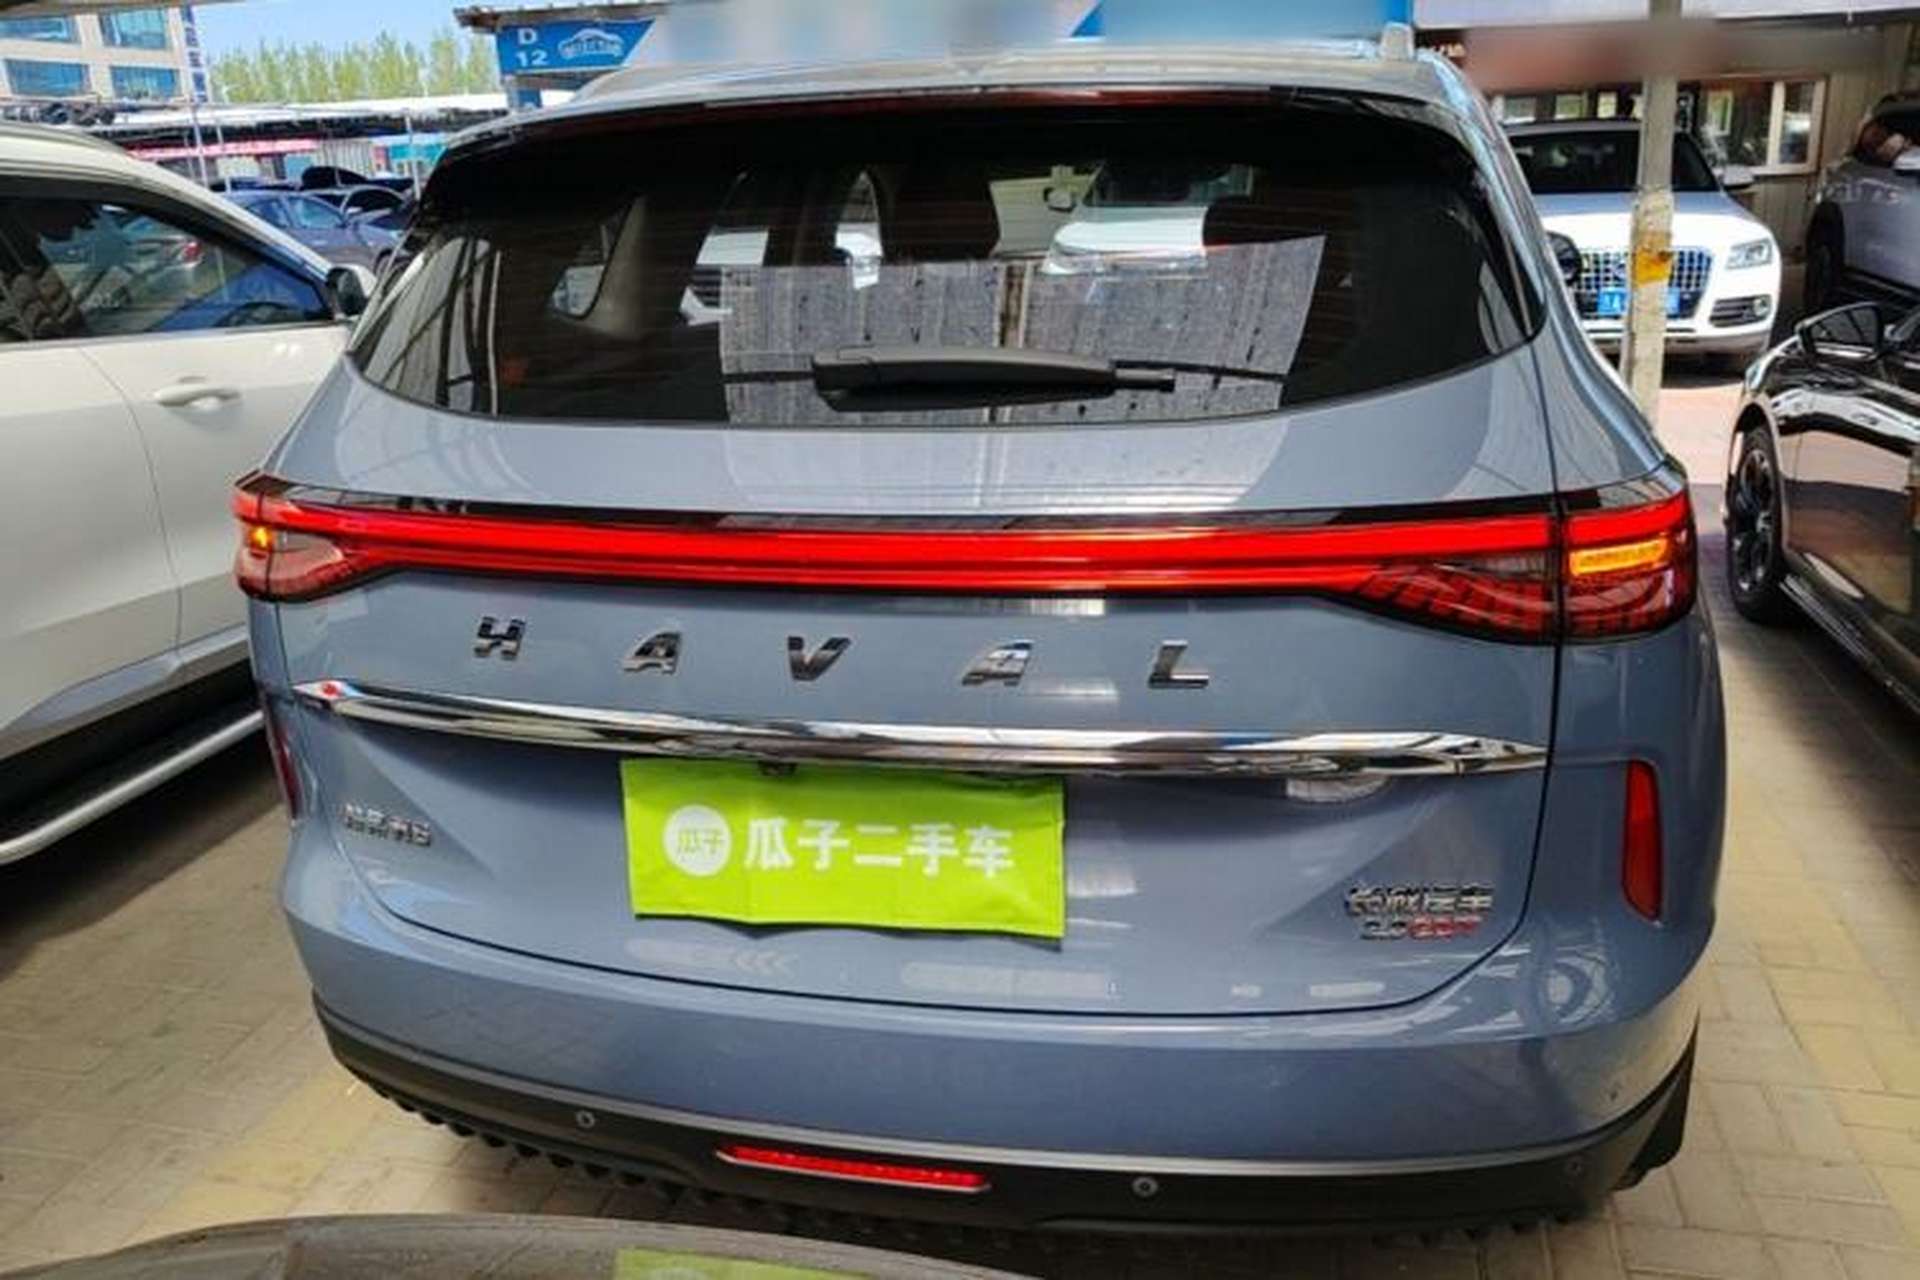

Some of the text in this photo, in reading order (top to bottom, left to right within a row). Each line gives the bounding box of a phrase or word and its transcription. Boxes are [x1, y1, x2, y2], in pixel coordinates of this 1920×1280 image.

[518, 28, 537, 45] D
[517, 49, 549, 67] 12
[474, 616, 1210, 689] HAVAL
[744, 817, 1015, 877] 瓜子二手车
